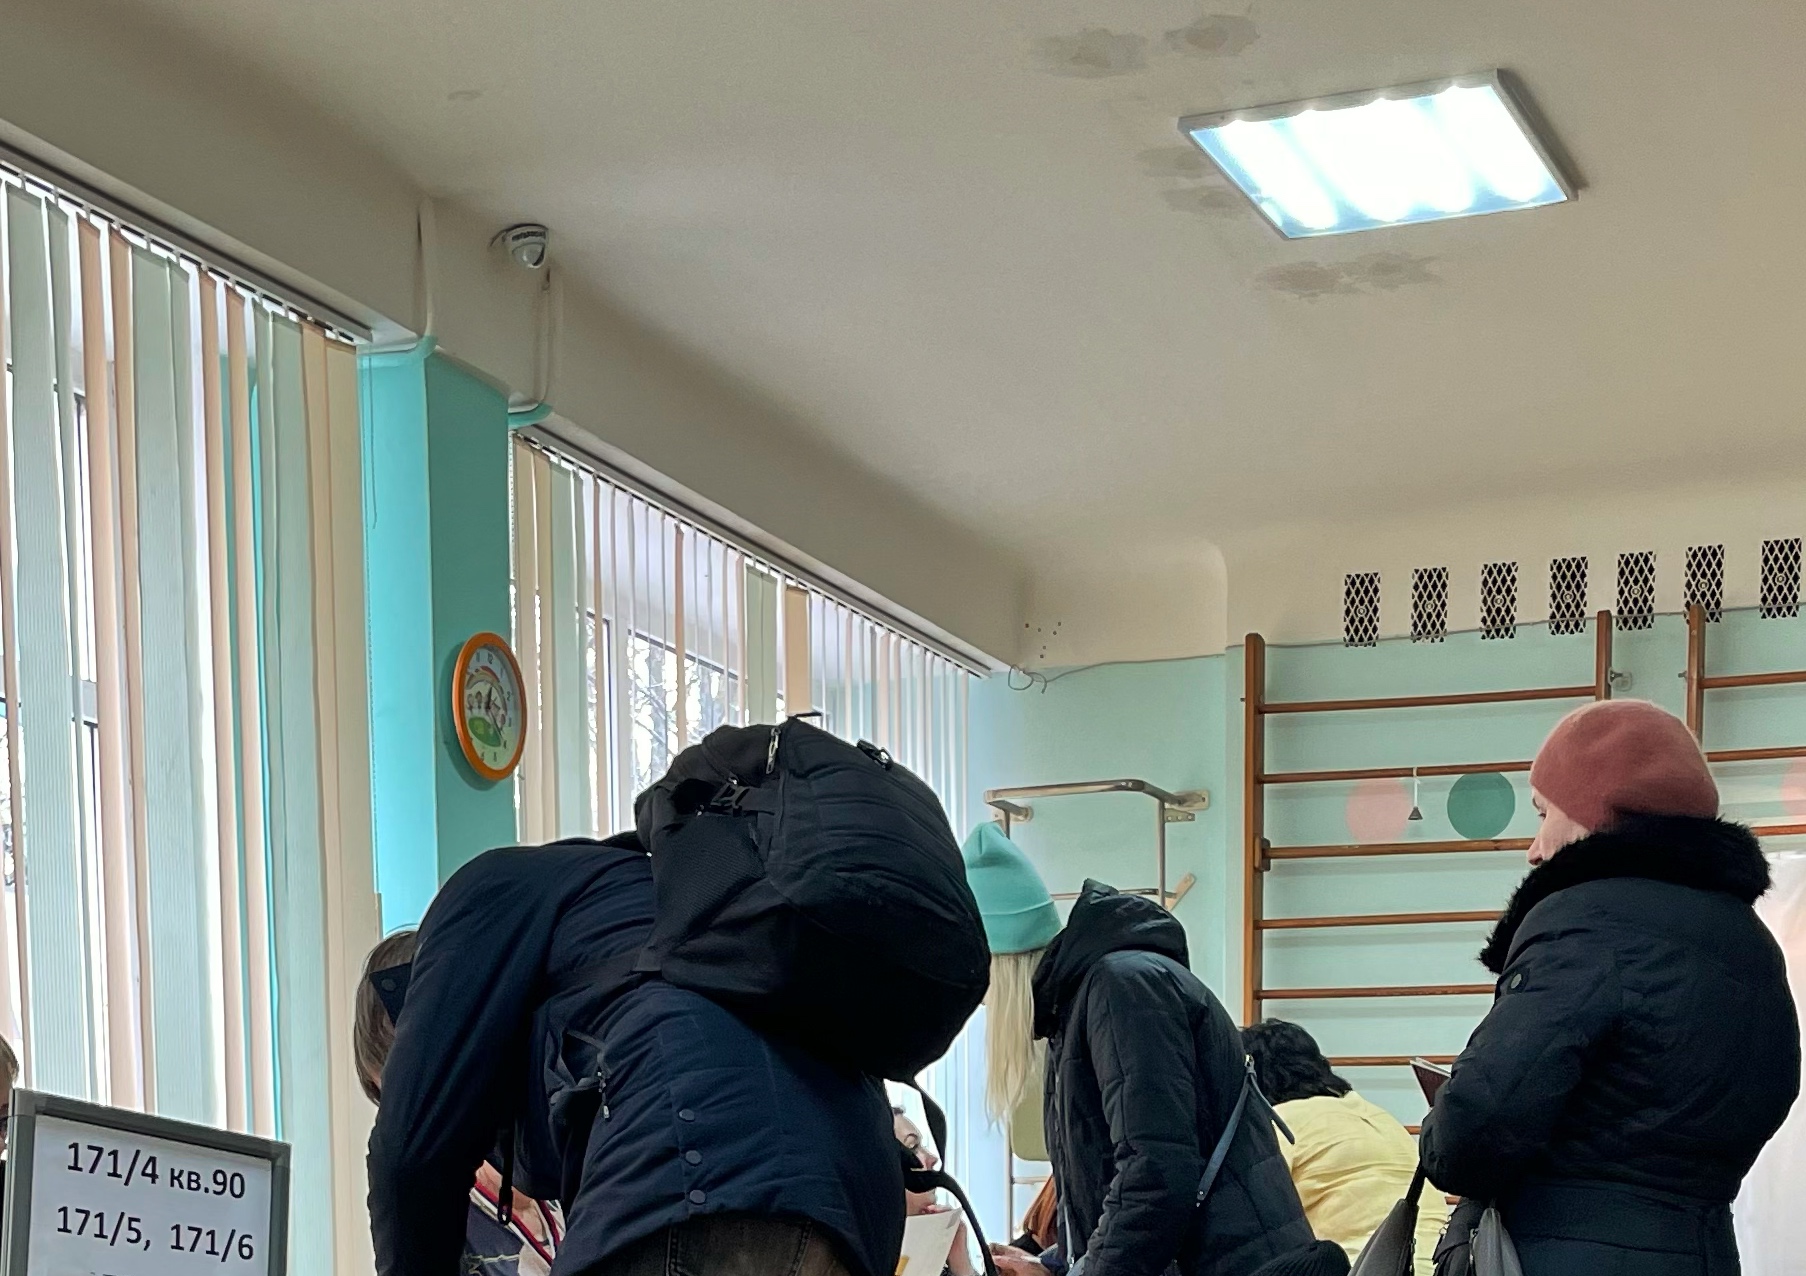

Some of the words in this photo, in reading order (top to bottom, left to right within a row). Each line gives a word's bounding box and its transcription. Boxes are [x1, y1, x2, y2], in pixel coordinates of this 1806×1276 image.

[67, 1142, 159, 1187] 171/4
[169, 1168, 246, 1199] кв.90
[57, 1206, 151, 1251] 171/5,
[170, 1224, 254, 1262] 171/6
